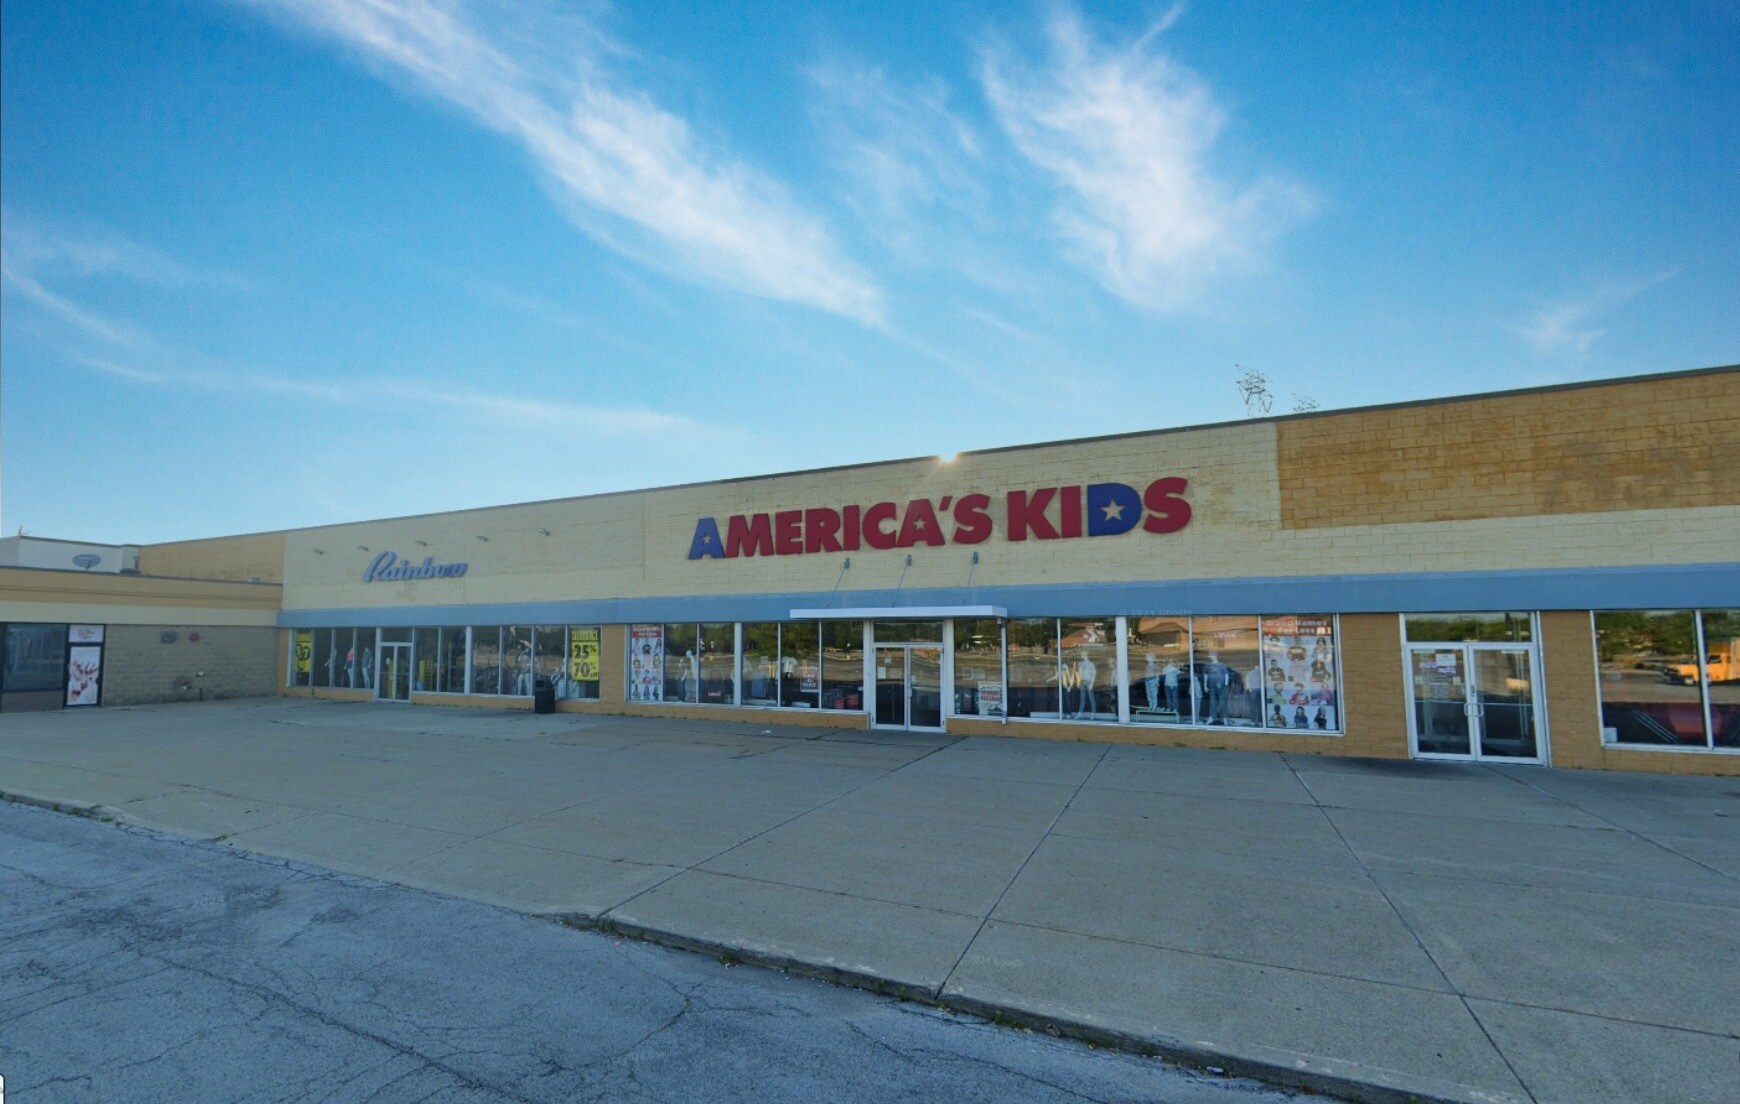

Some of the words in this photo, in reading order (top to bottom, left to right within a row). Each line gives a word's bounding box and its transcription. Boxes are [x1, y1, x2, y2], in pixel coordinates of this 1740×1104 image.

[688, 494, 992, 560] AMERICA'S
[1007, 477, 1193, 541] KIDS
[362, 551, 468, 583] Rainbow
[574, 644, 597, 660] 25%
[573, 661, 597, 677] 70%
